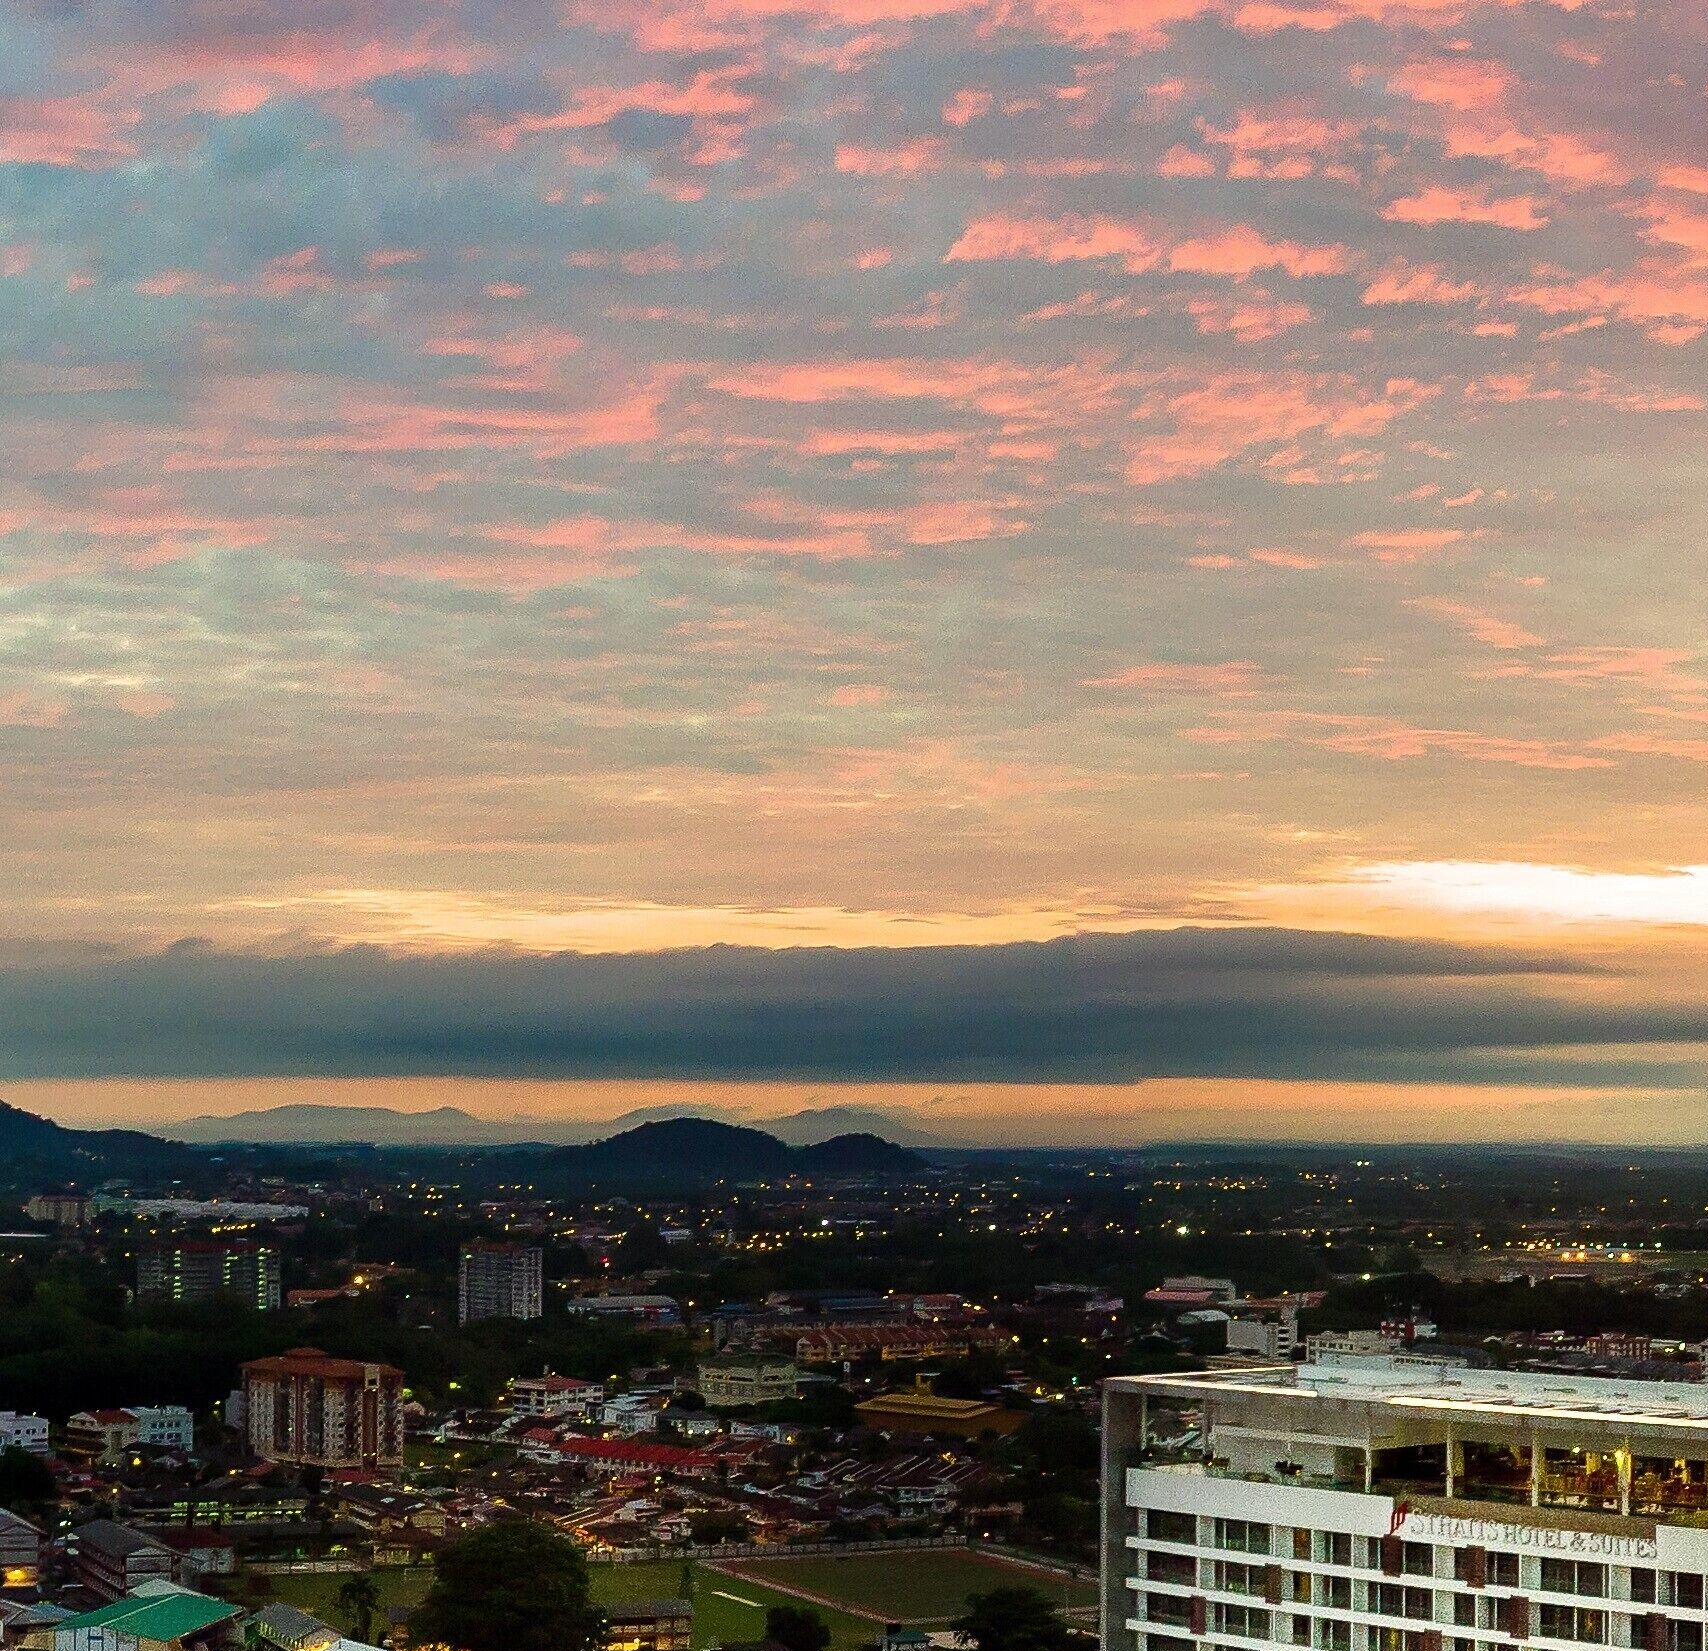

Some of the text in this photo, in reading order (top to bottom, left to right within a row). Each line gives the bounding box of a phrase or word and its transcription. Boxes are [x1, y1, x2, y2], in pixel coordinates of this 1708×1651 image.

[1411, 1508, 1657, 1560] STRAITS HOTEL & SUITES
